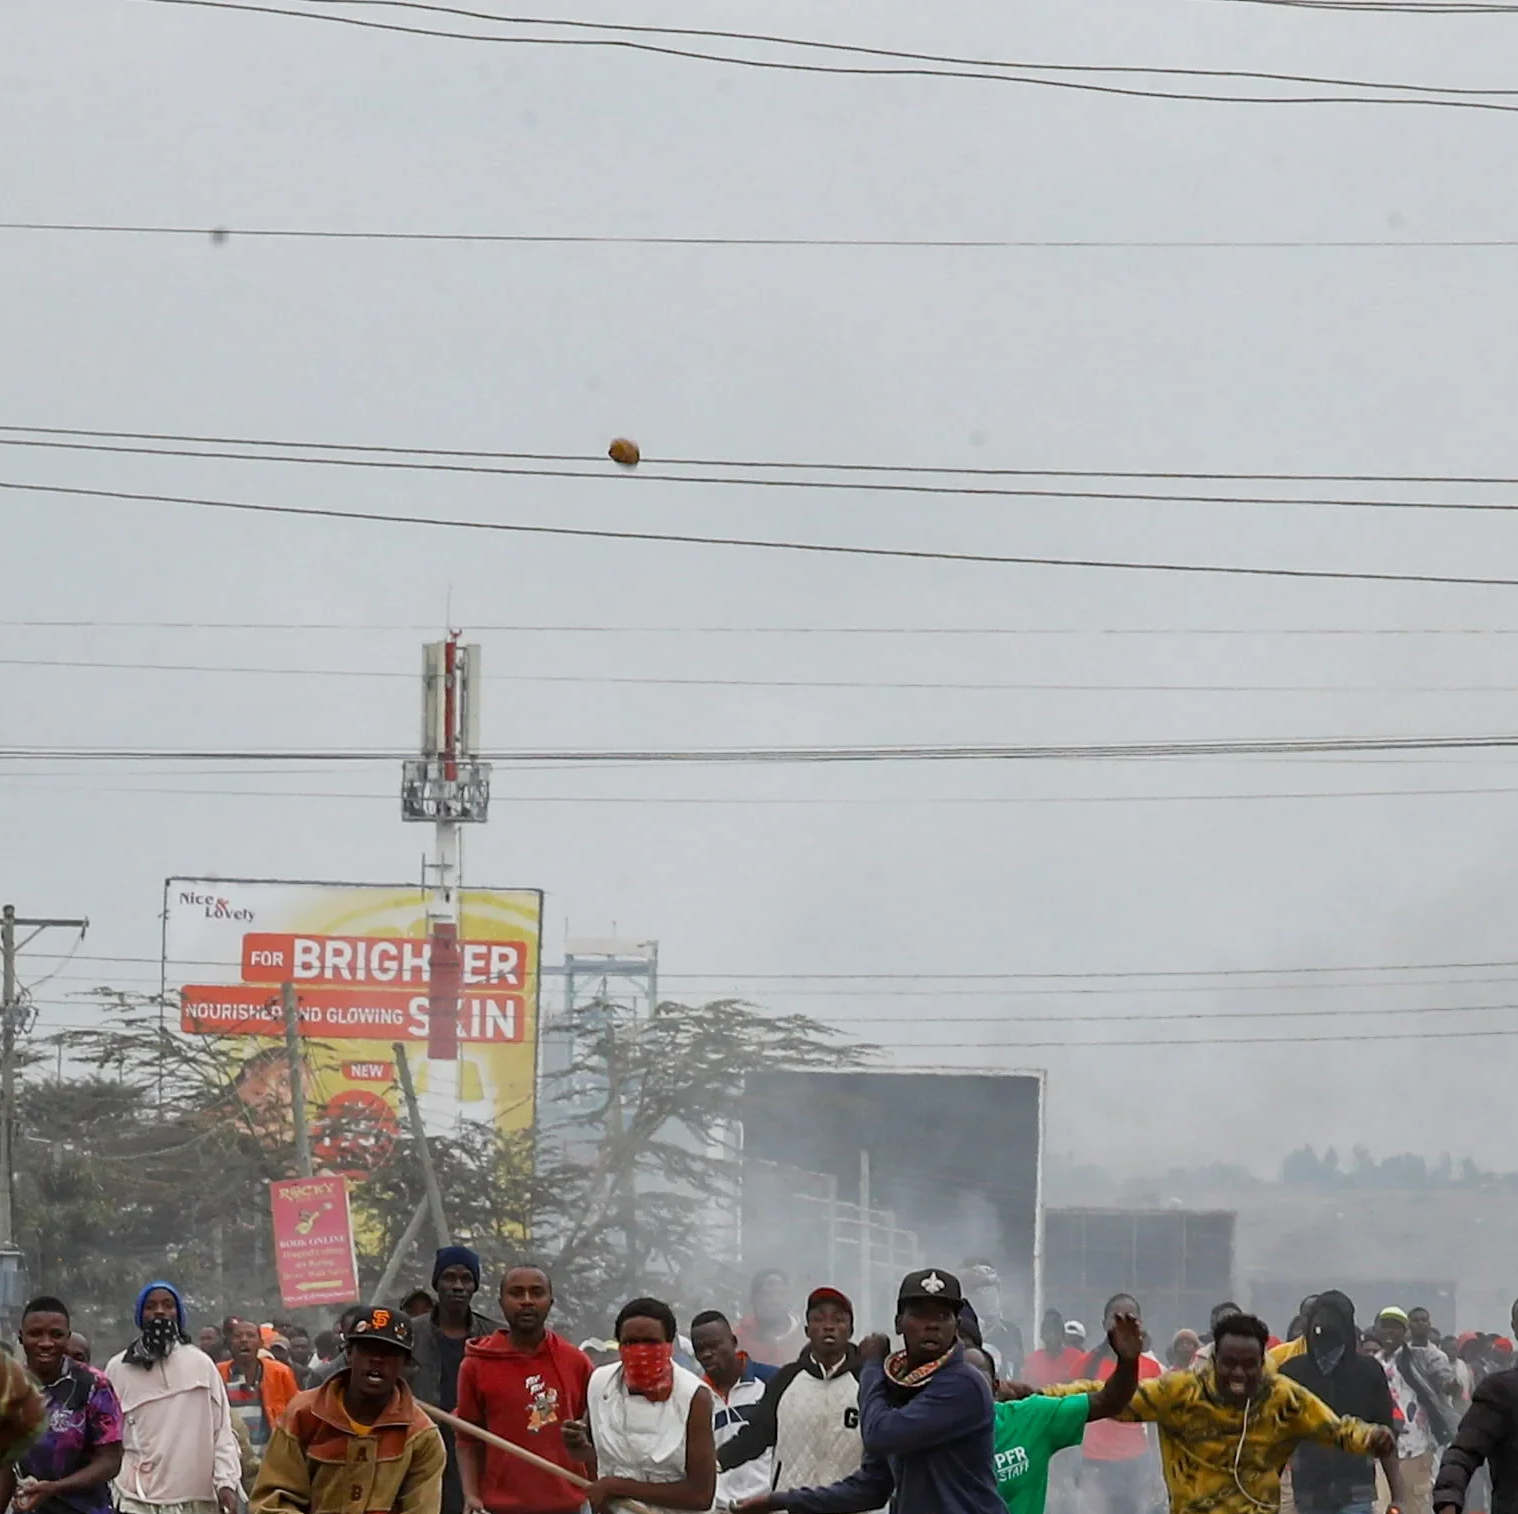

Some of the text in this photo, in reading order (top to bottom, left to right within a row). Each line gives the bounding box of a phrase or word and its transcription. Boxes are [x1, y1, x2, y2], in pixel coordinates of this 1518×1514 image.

[179, 892, 214, 905] Nice
[205, 906, 255, 922] Lovely
[251, 938, 518, 985] FOR BRIGHER
[293, 1006, 321, 1022] ND
[326, 1008, 403, 1025] GLOWING
[351, 1064, 383, 1078] NEW
[844, 1407, 859, 1429] G
[355, 1447, 369, 1461] A
[994, 1446, 1027, 1469] PFR
[351, 1484, 362, 1500] B
